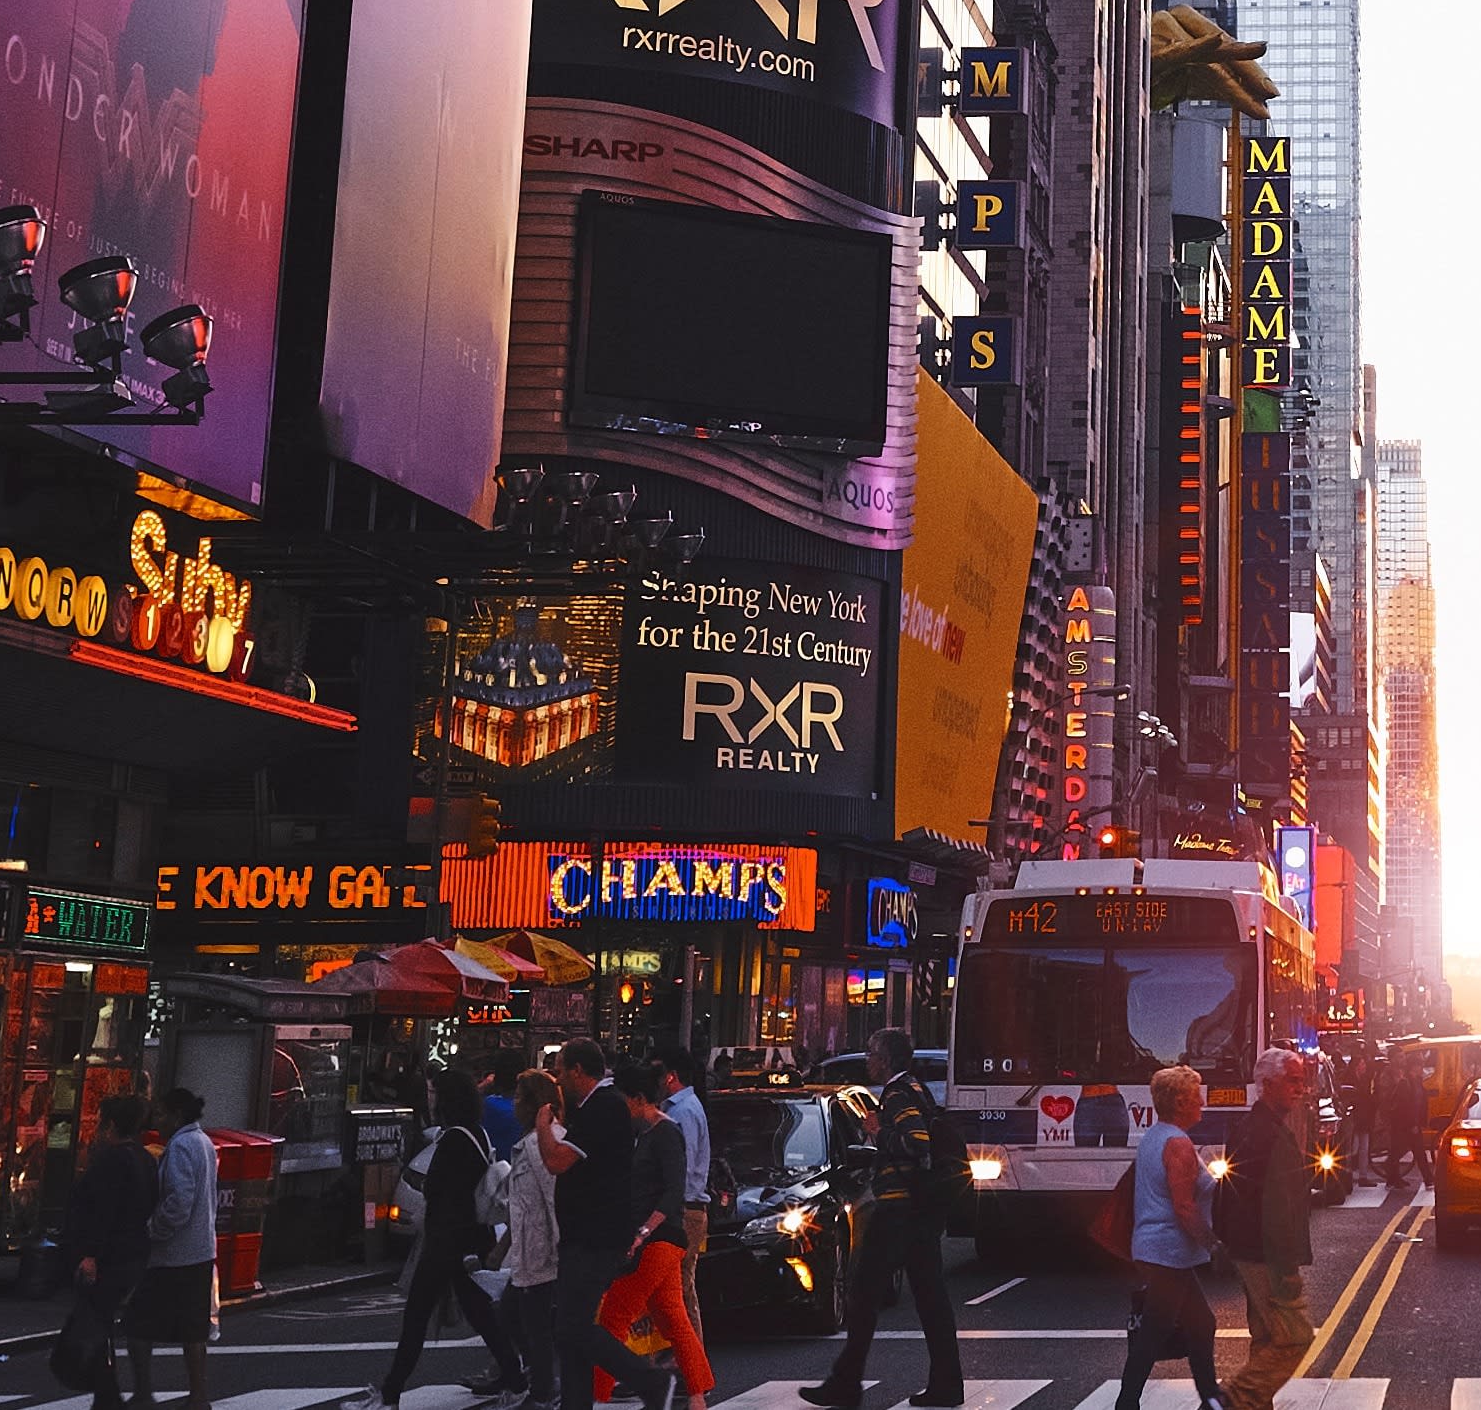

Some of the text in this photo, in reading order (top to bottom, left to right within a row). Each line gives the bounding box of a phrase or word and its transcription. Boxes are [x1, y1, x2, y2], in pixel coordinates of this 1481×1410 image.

[621, 25, 817, 83] rxrrealty.com
[523, 134, 665, 164] SHARP
[160, 132, 273, 241] WOMAN
[68, 220, 83, 241] OF
[1247, 137, 1288, 385] MADAME
[68, 310, 136, 354] JE
[826, 473, 896, 514] AQUOS
[767, 581, 823, 618] New
[827, 589, 867, 624] York
[637, 618, 872, 677] for the 21st Century
[681, 670, 845, 753] RXR
[716, 747, 821, 774] REALTY
[193, 865, 314, 910] KNOW
[549, 854, 788, 915] CHAMPS
[58, 900, 134, 943] WATER
[876, 887, 919, 940] CHAMPS
[1007, 900, 1058, 934] M42
[1095, 901, 1168, 918] EAST SIDE
[586, 949, 663, 976] AMPS
[979, 1110, 1006, 1122] 3930
